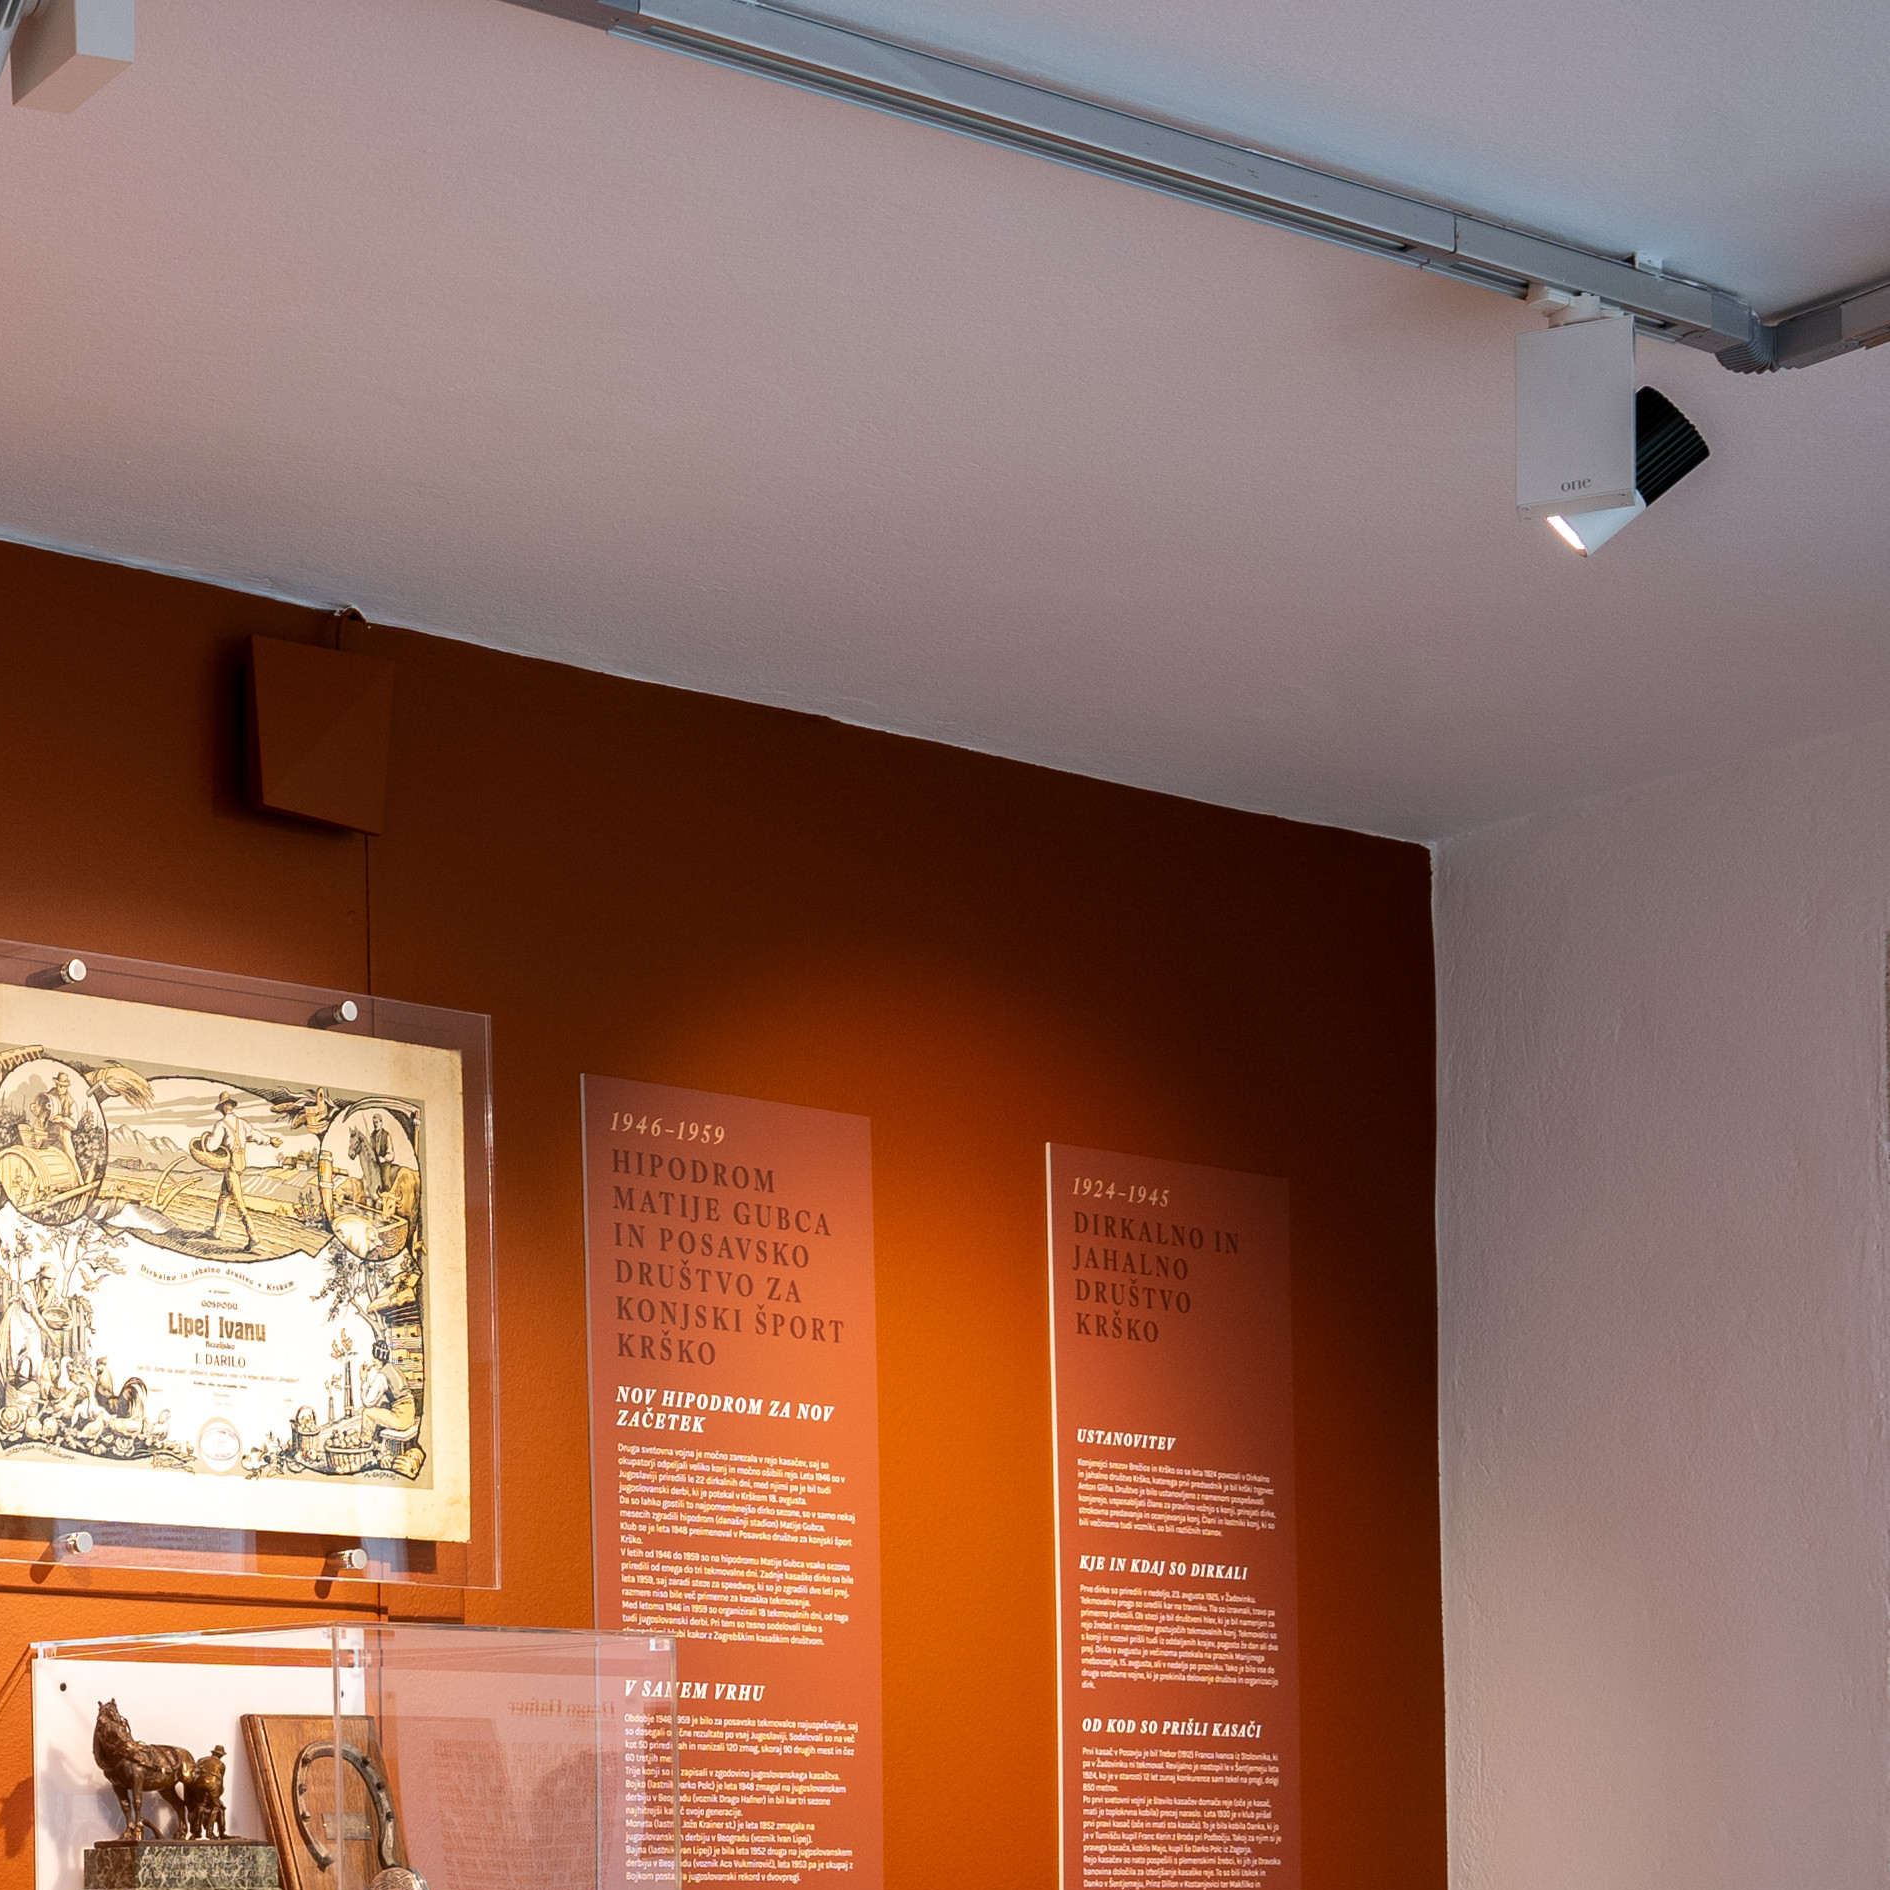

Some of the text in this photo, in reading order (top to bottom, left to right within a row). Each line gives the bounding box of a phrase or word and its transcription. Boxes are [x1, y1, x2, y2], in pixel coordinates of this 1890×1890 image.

[611, 1112, 724, 1144] 1946–1959
[613, 1149, 773, 1192] HIPODROM
[1073, 1177, 1168, 1206] 1924–1945
[614, 1186, 830, 1236] MATIJE GUBCA
[615, 1223, 808, 1267] IN POSAVSKO
[1074, 1211, 1237, 1253] DIRKALNO IN
[1072, 1245, 1187, 1279] JAHALNO
[616, 1259, 800, 1302] DRUŠTVO ZA
[1076, 1279, 1190, 1313] DRUŠTVO
[201, 1299, 238, 1310] GOSPODU
[617, 1296, 843, 1342] KONJSKI ŠPORT
[168, 1312, 266, 1342] Lipej Ivanu
[1076, 1310, 1157, 1342] KRŠKO
[205, 1353, 246, 1368] DARILO
[618, 1333, 715, 1365] KRŠKO
[616, 1386, 834, 1421] NOV HIPODROM ZA NOV
[616, 1407, 705, 1432] ZAČETEK
[1077, 1429, 1175, 1450] USTANOVITEV
[620, 1534, 642, 1543] Krško.
[1079, 1555, 1247, 1579] KJE IN KDAJ SO DIRKALI
[626, 1680, 636, 1695] V
[715, 1683, 764, 1701] VRHU
[1082, 1718, 1261, 1737] OD KOD SO PRIŠLI KASAČI
